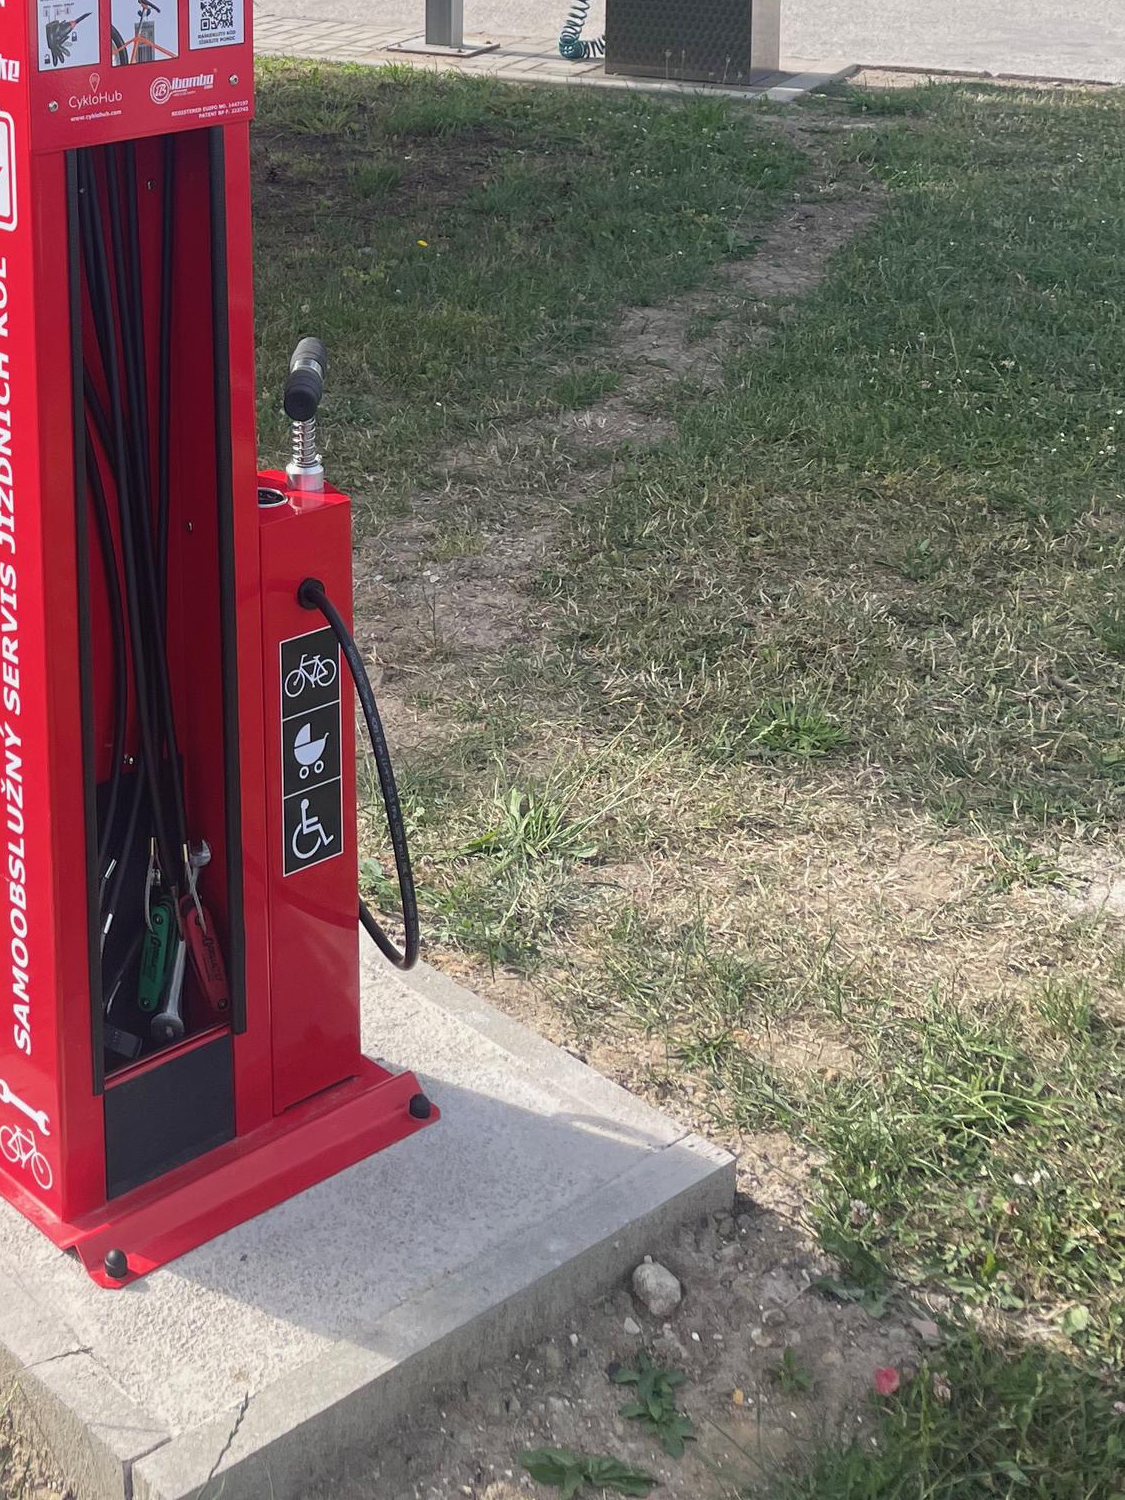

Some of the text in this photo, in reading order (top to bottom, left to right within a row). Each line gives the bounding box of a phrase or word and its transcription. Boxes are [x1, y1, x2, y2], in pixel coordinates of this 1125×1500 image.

[68, 90, 123, 110] CykloHub
[0, 562, 21, 716] SERVIS
[0, 721, 32, 1056] SAMOOBSLUŽNÝ
